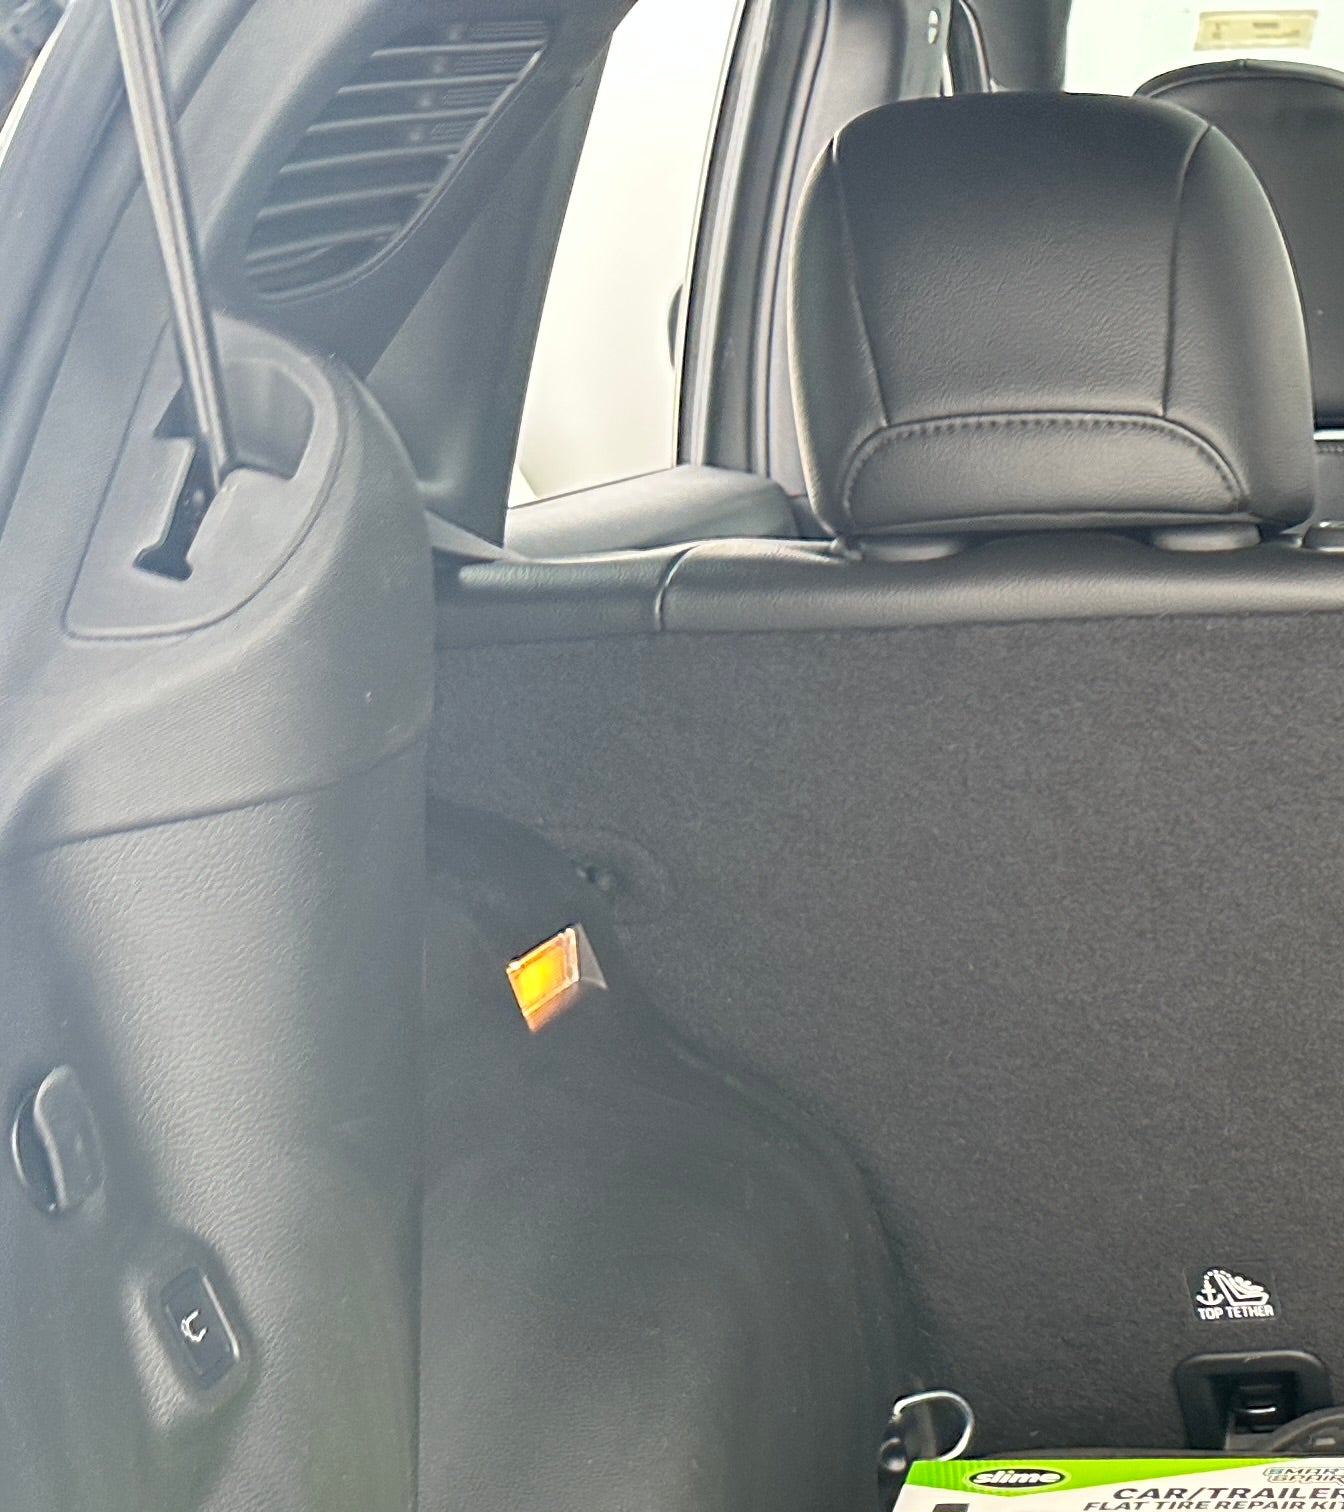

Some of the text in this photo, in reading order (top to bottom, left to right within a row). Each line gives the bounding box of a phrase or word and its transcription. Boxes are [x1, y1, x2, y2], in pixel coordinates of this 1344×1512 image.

[1198, 1305, 1275, 1320] TOP TETHER
[972, 1470, 1061, 1484] slime
[1083, 1502, 1149, 1511] FLAT
[1155, 1501, 1211, 1510] TIRE
[1213, 1501, 1306, 1510] REPAIR
